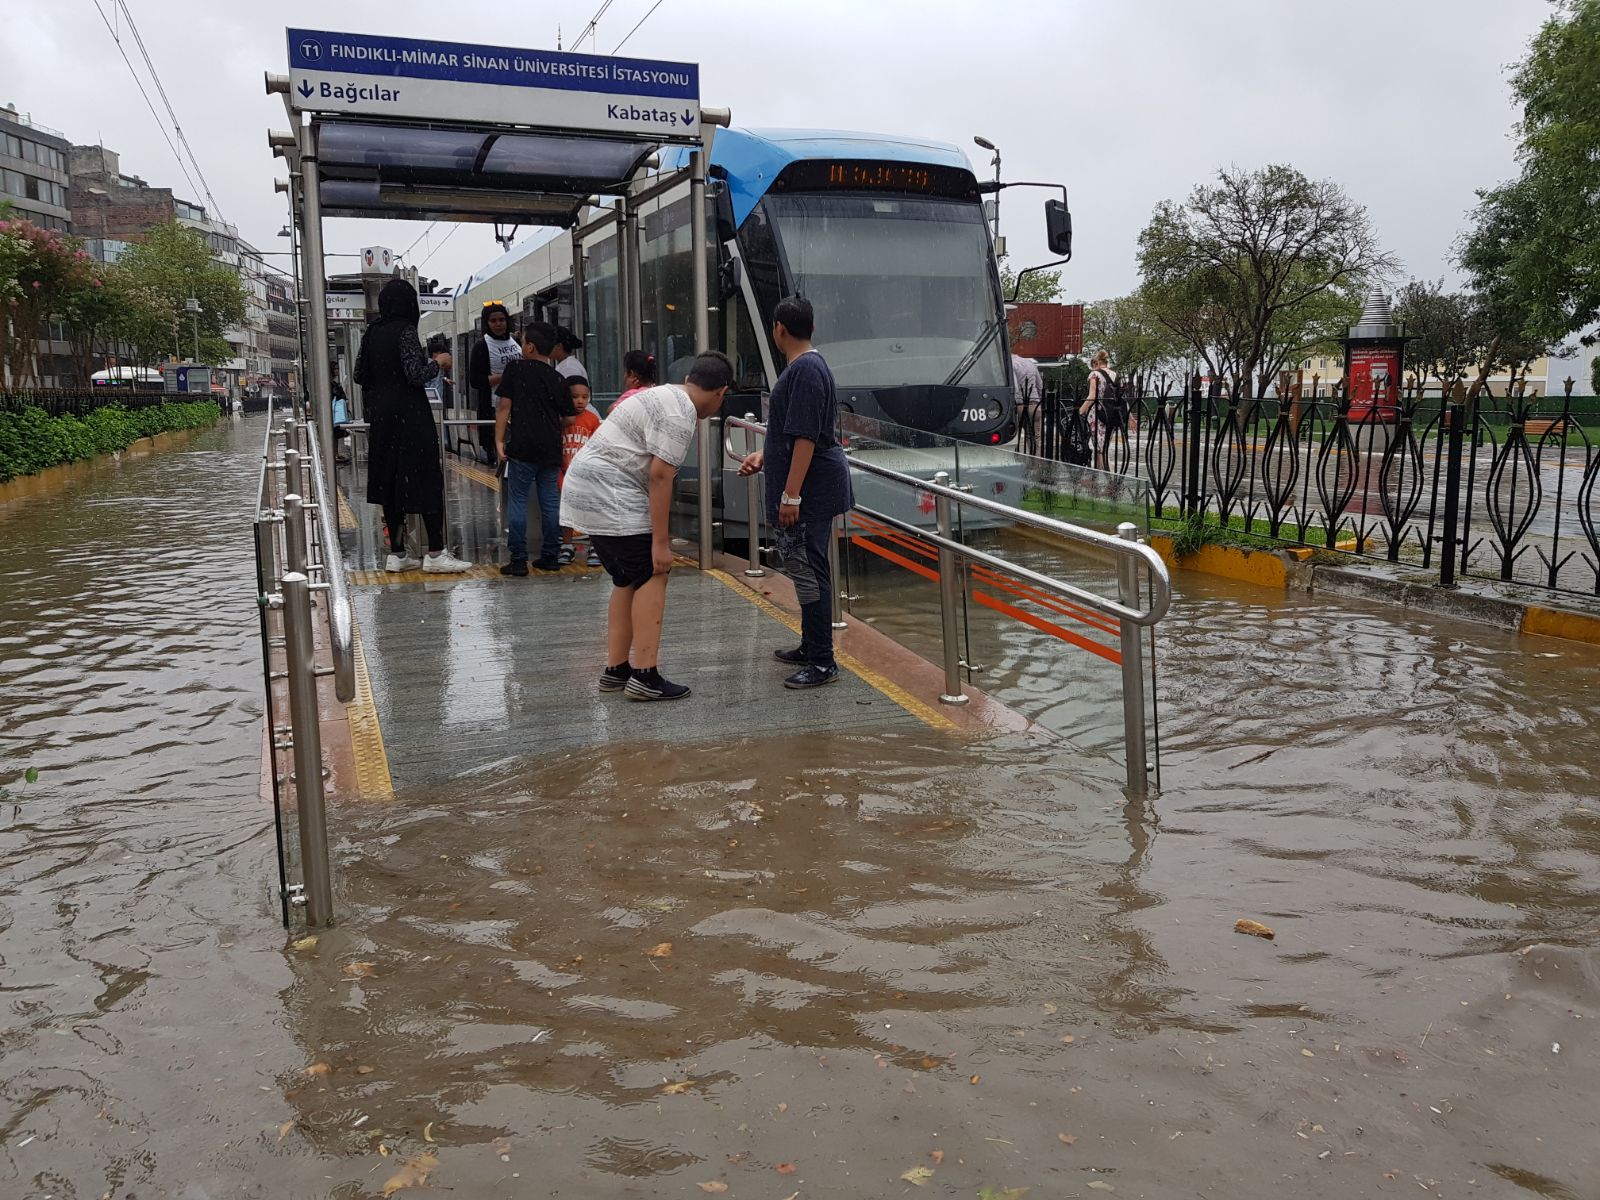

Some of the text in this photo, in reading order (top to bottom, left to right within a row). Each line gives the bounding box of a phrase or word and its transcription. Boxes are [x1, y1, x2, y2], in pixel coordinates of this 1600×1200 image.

[302, 44, 689, 86] T1 FINDIKLI-MİMAR SİNAN ÜNİVERSİTESİ İSTASYONU
[320, 82, 400, 103] Bağcılar
[607, 104, 677, 126] Kabataş
[326, 296, 347, 304] ğcılar
[961, 408, 987, 422] 708
